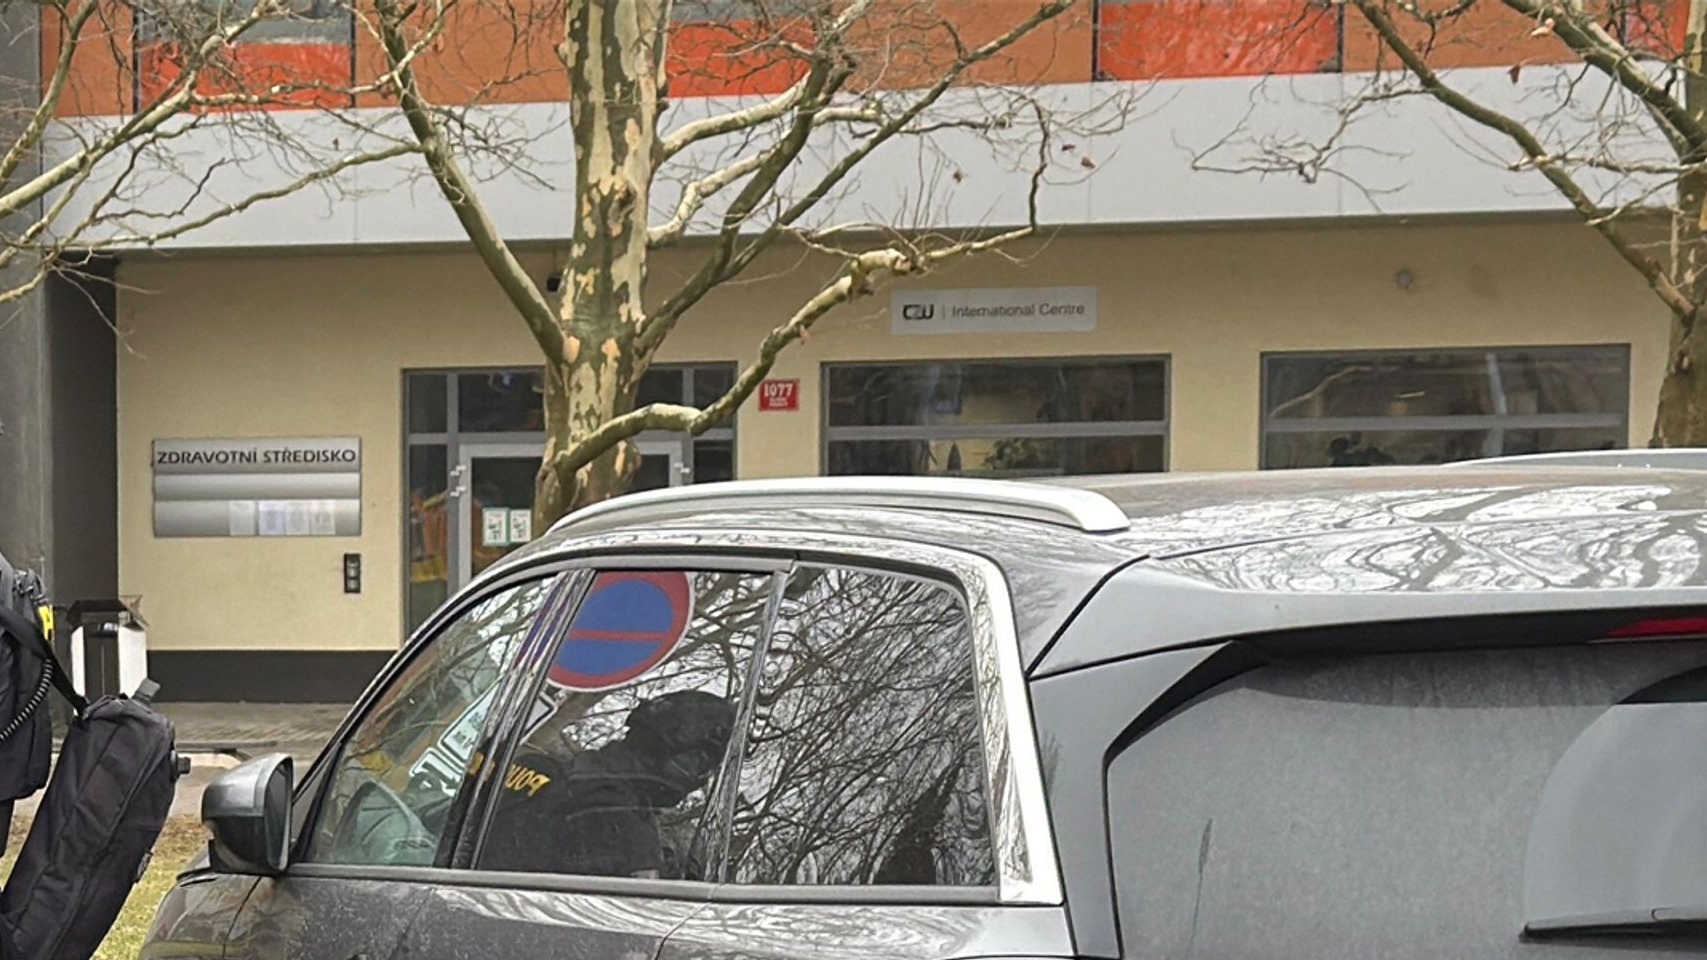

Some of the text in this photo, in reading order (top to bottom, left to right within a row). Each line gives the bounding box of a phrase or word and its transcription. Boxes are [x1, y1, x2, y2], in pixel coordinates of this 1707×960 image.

[952, 304, 1035, 318] International
[1039, 302, 1086, 316] Centre
[763, 383, 794, 398] 1077
[157, 447, 357, 464] ZDRAVOTNÍ STŘEDISKO
